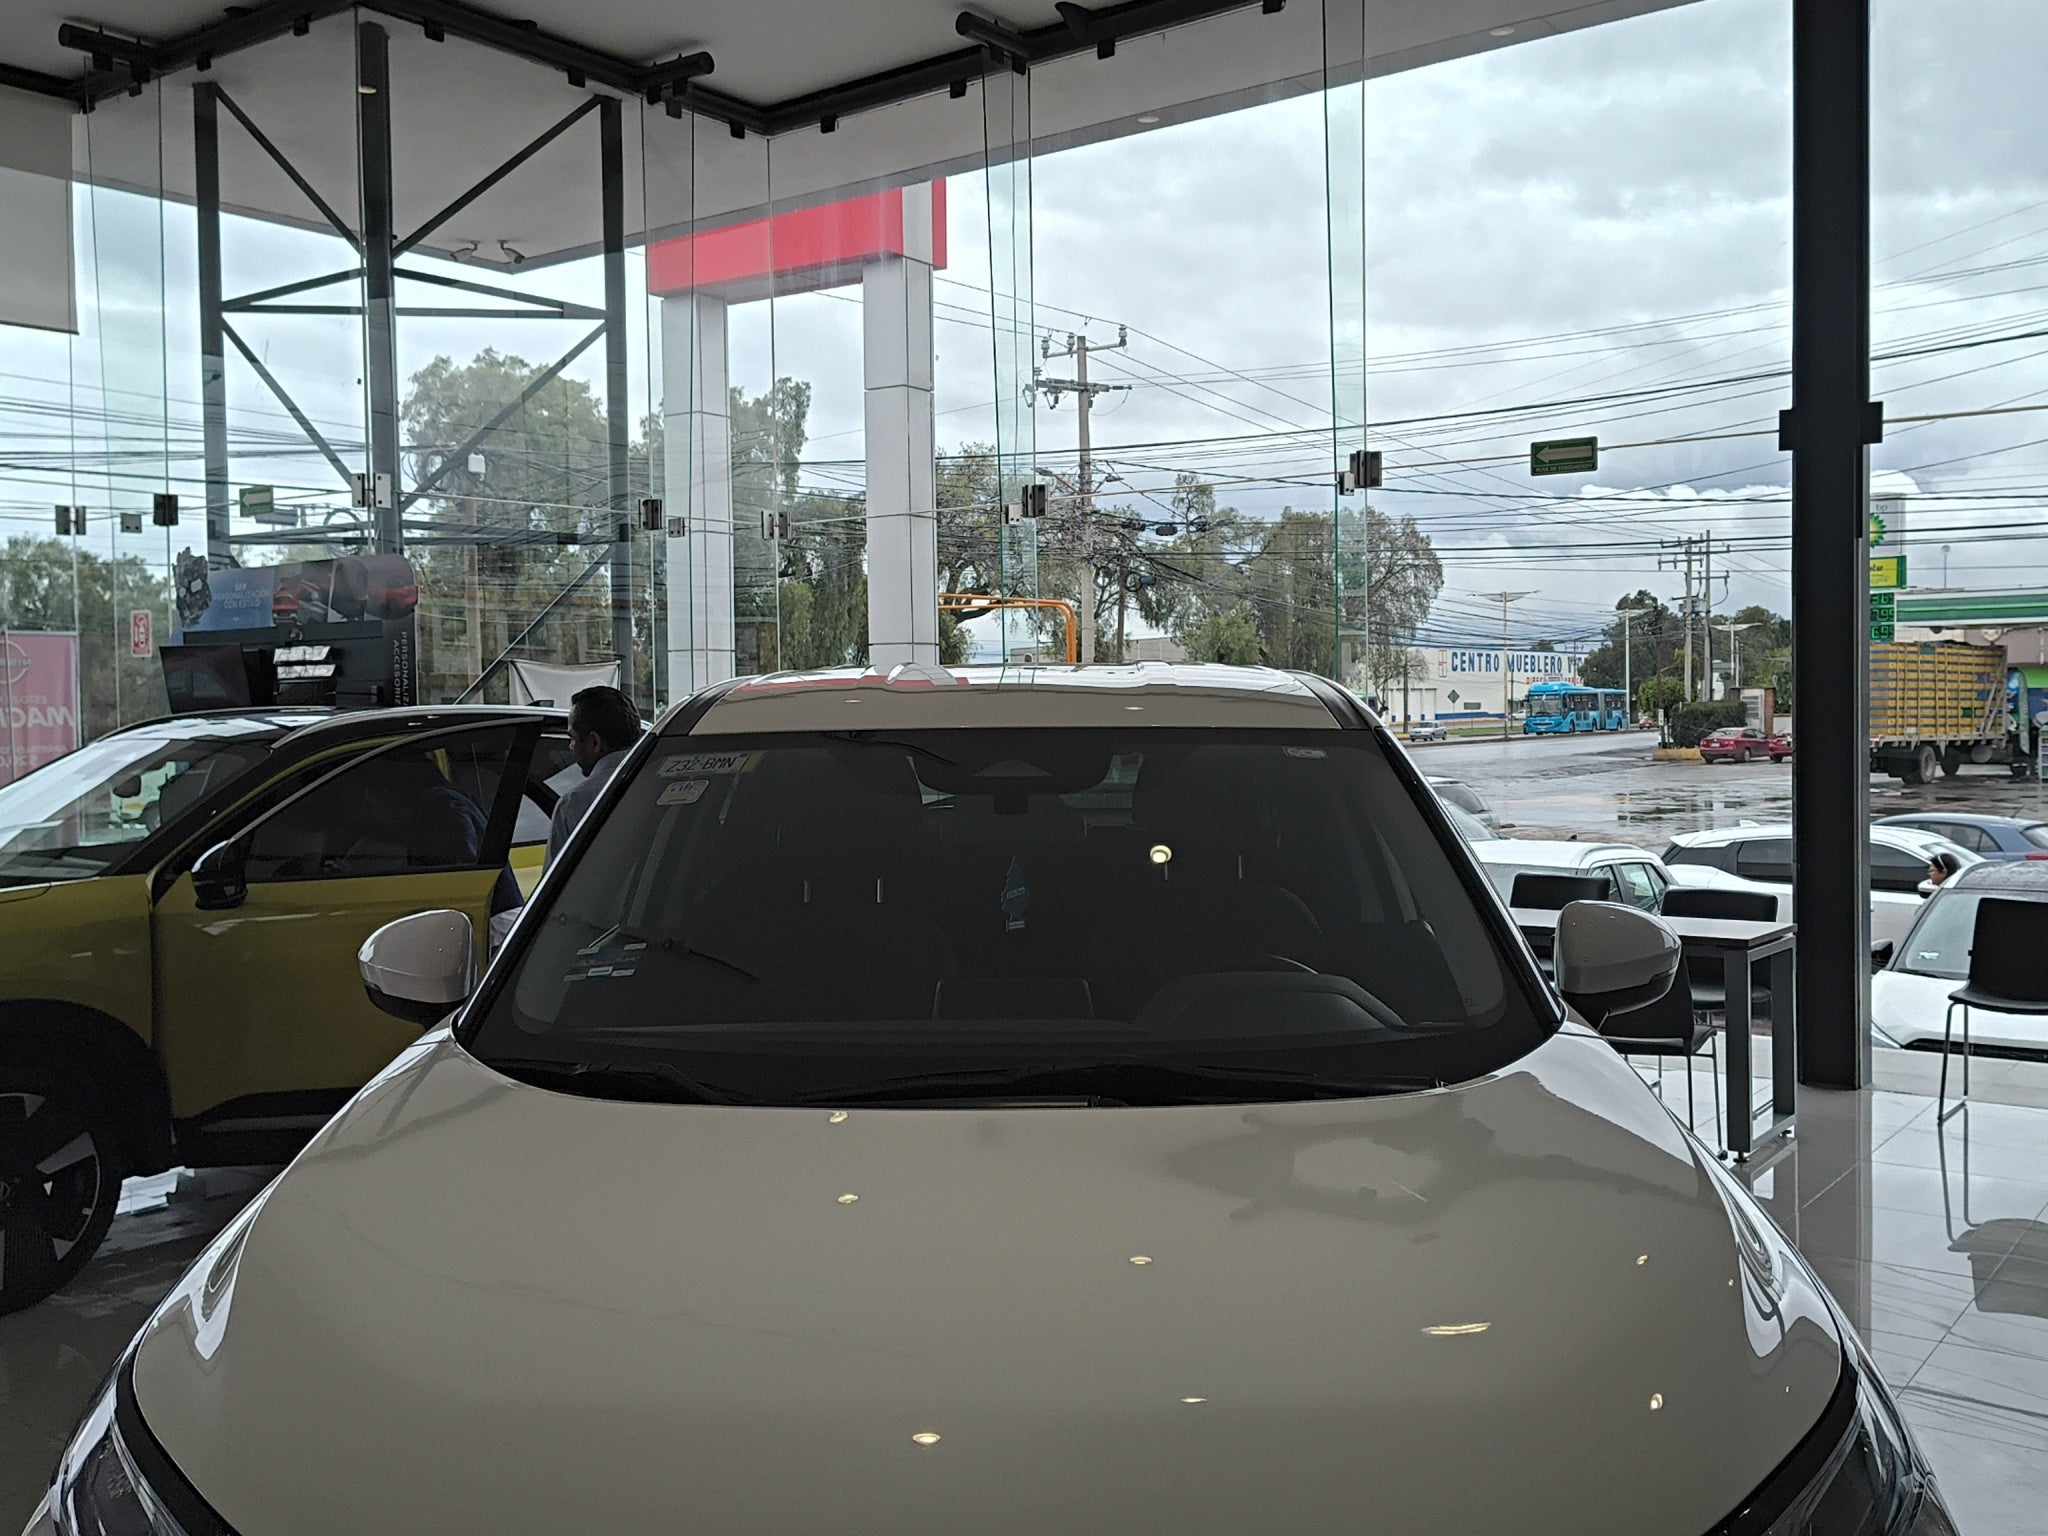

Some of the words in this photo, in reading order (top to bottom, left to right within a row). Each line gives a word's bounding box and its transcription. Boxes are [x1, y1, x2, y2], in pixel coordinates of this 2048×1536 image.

[401, 631, 409, 706] PERSONALIZ
[1451, 651, 1500, 672] CENTRO
[1507, 654, 1562, 673] MUEBLERO
